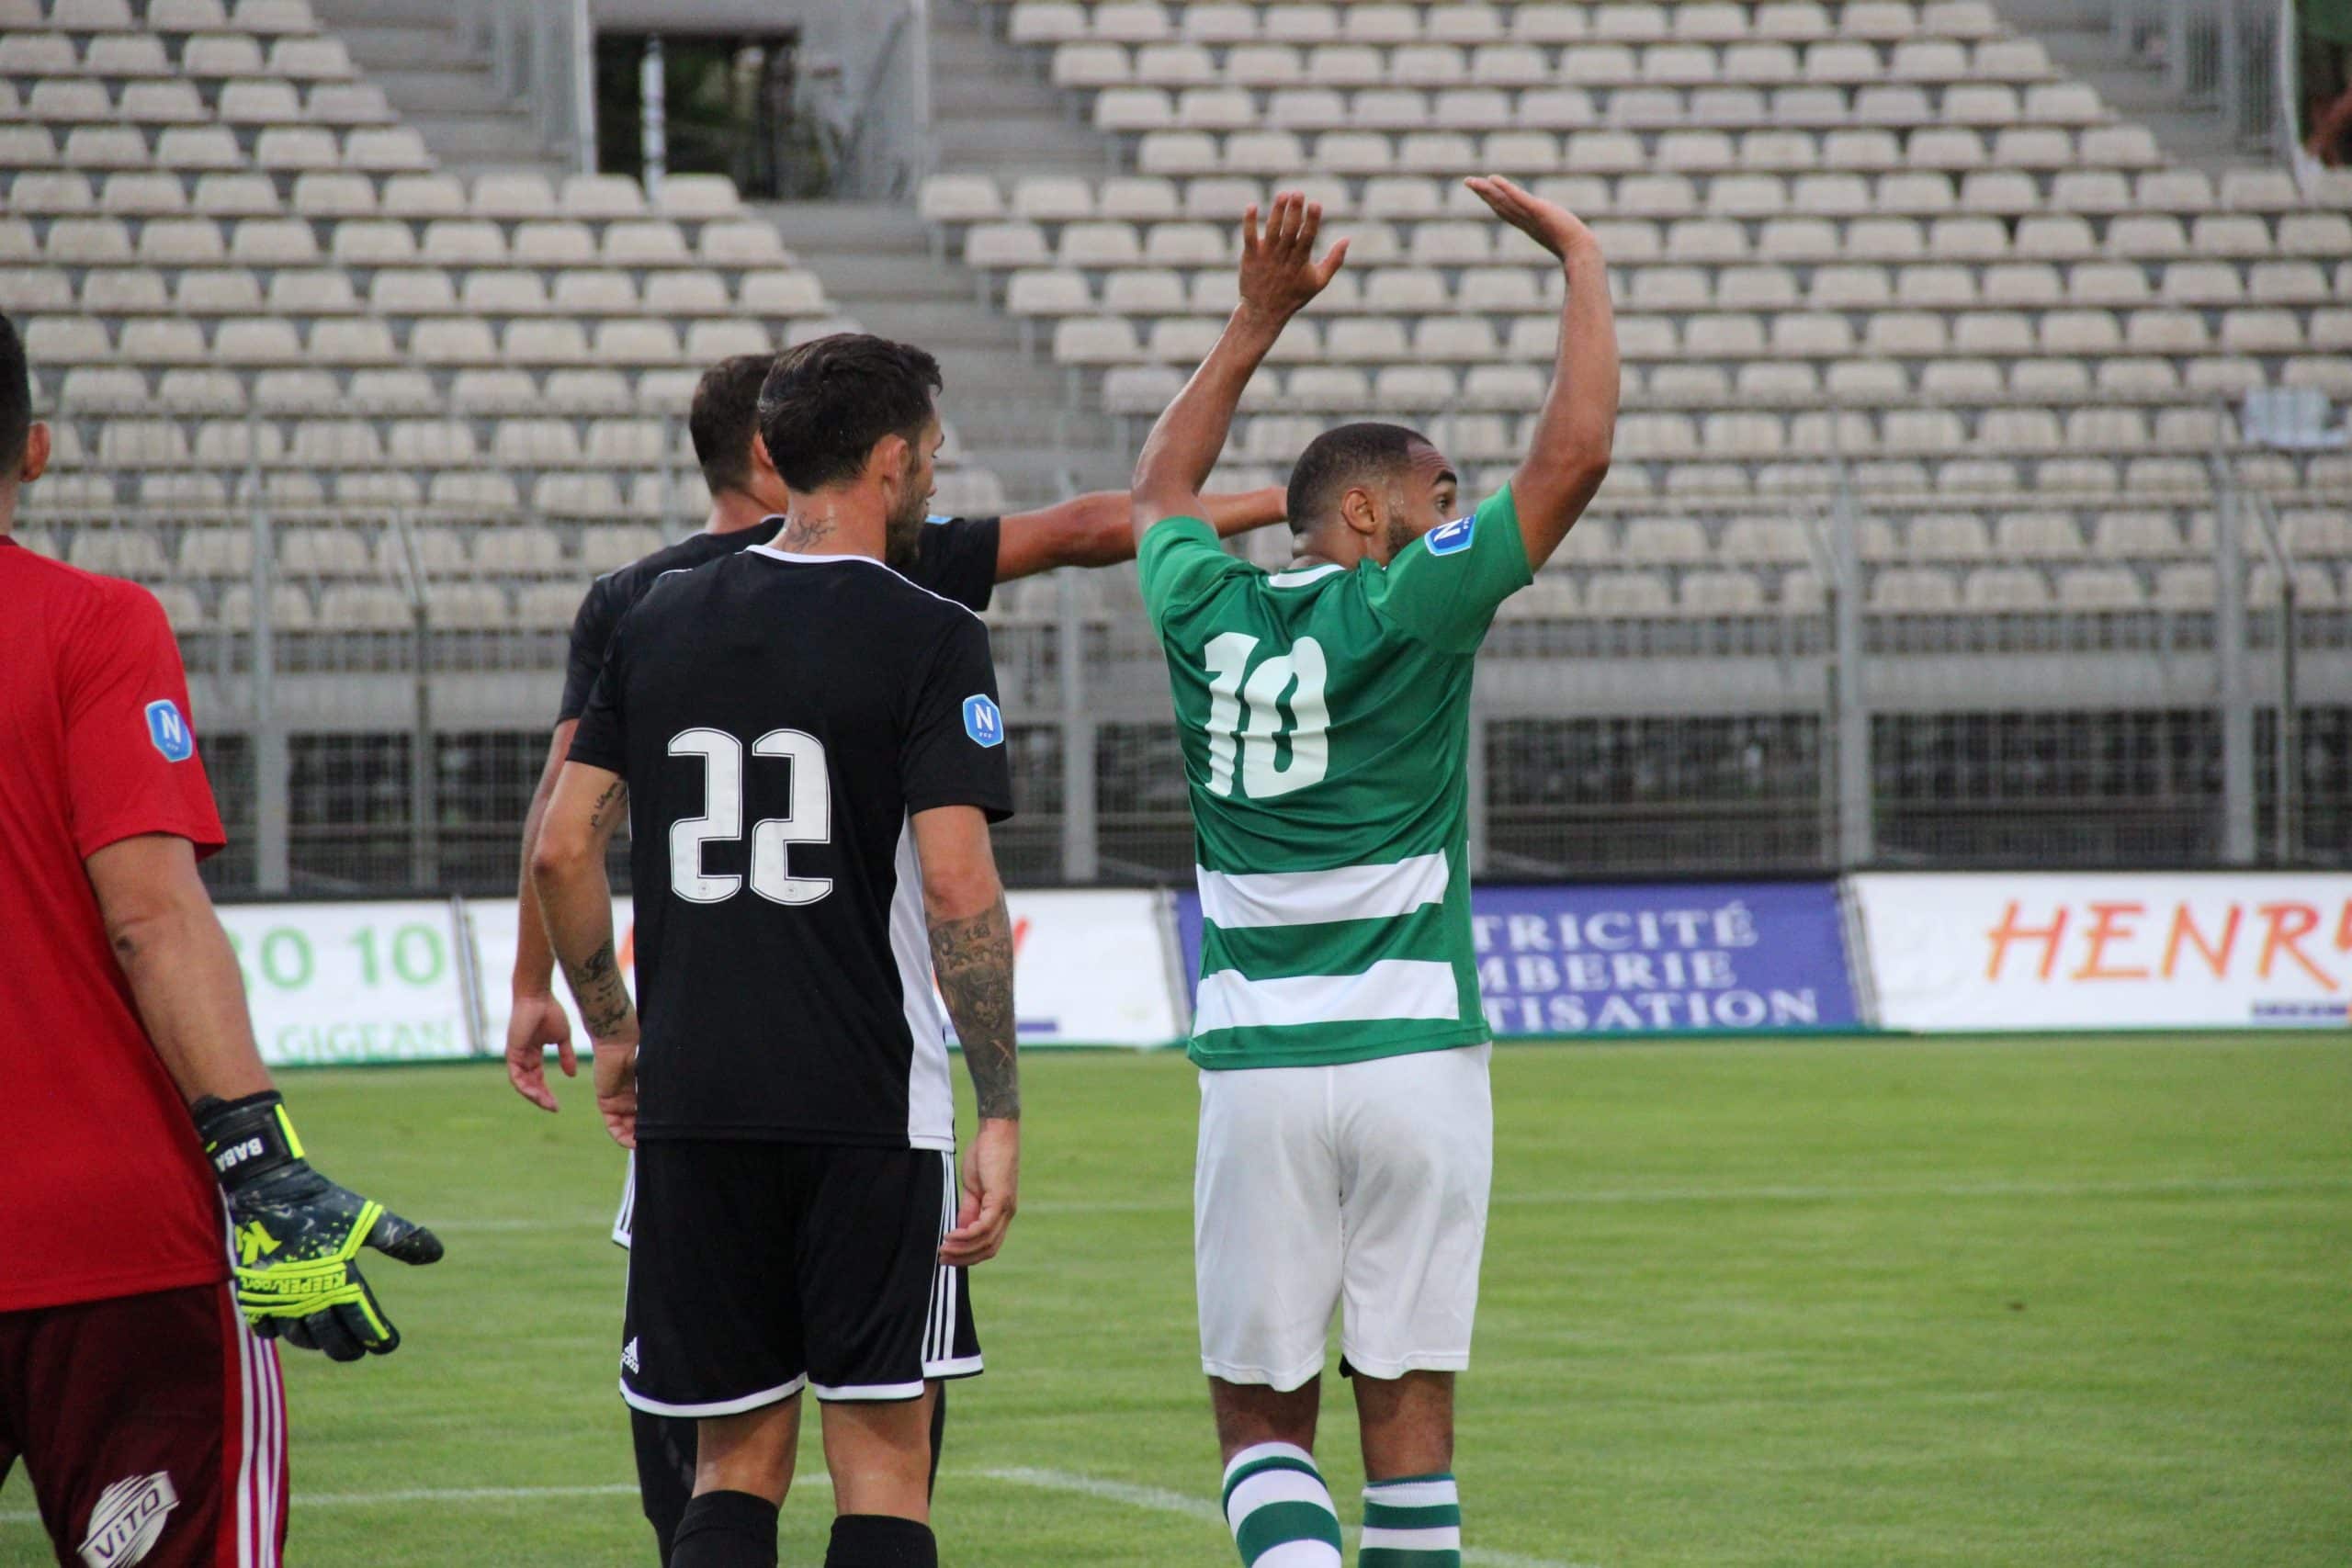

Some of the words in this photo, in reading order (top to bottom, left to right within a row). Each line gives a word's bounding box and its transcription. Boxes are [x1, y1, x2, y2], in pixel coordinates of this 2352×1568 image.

[1433, 517, 1464, 542] N
[160, 709, 181, 743] N
[975, 703, 994, 731] N
[1204, 631, 1331, 799] 10
[668, 728, 832, 906] 22
[228, 924, 315, 991] 0
[349, 922, 445, 987] 10
